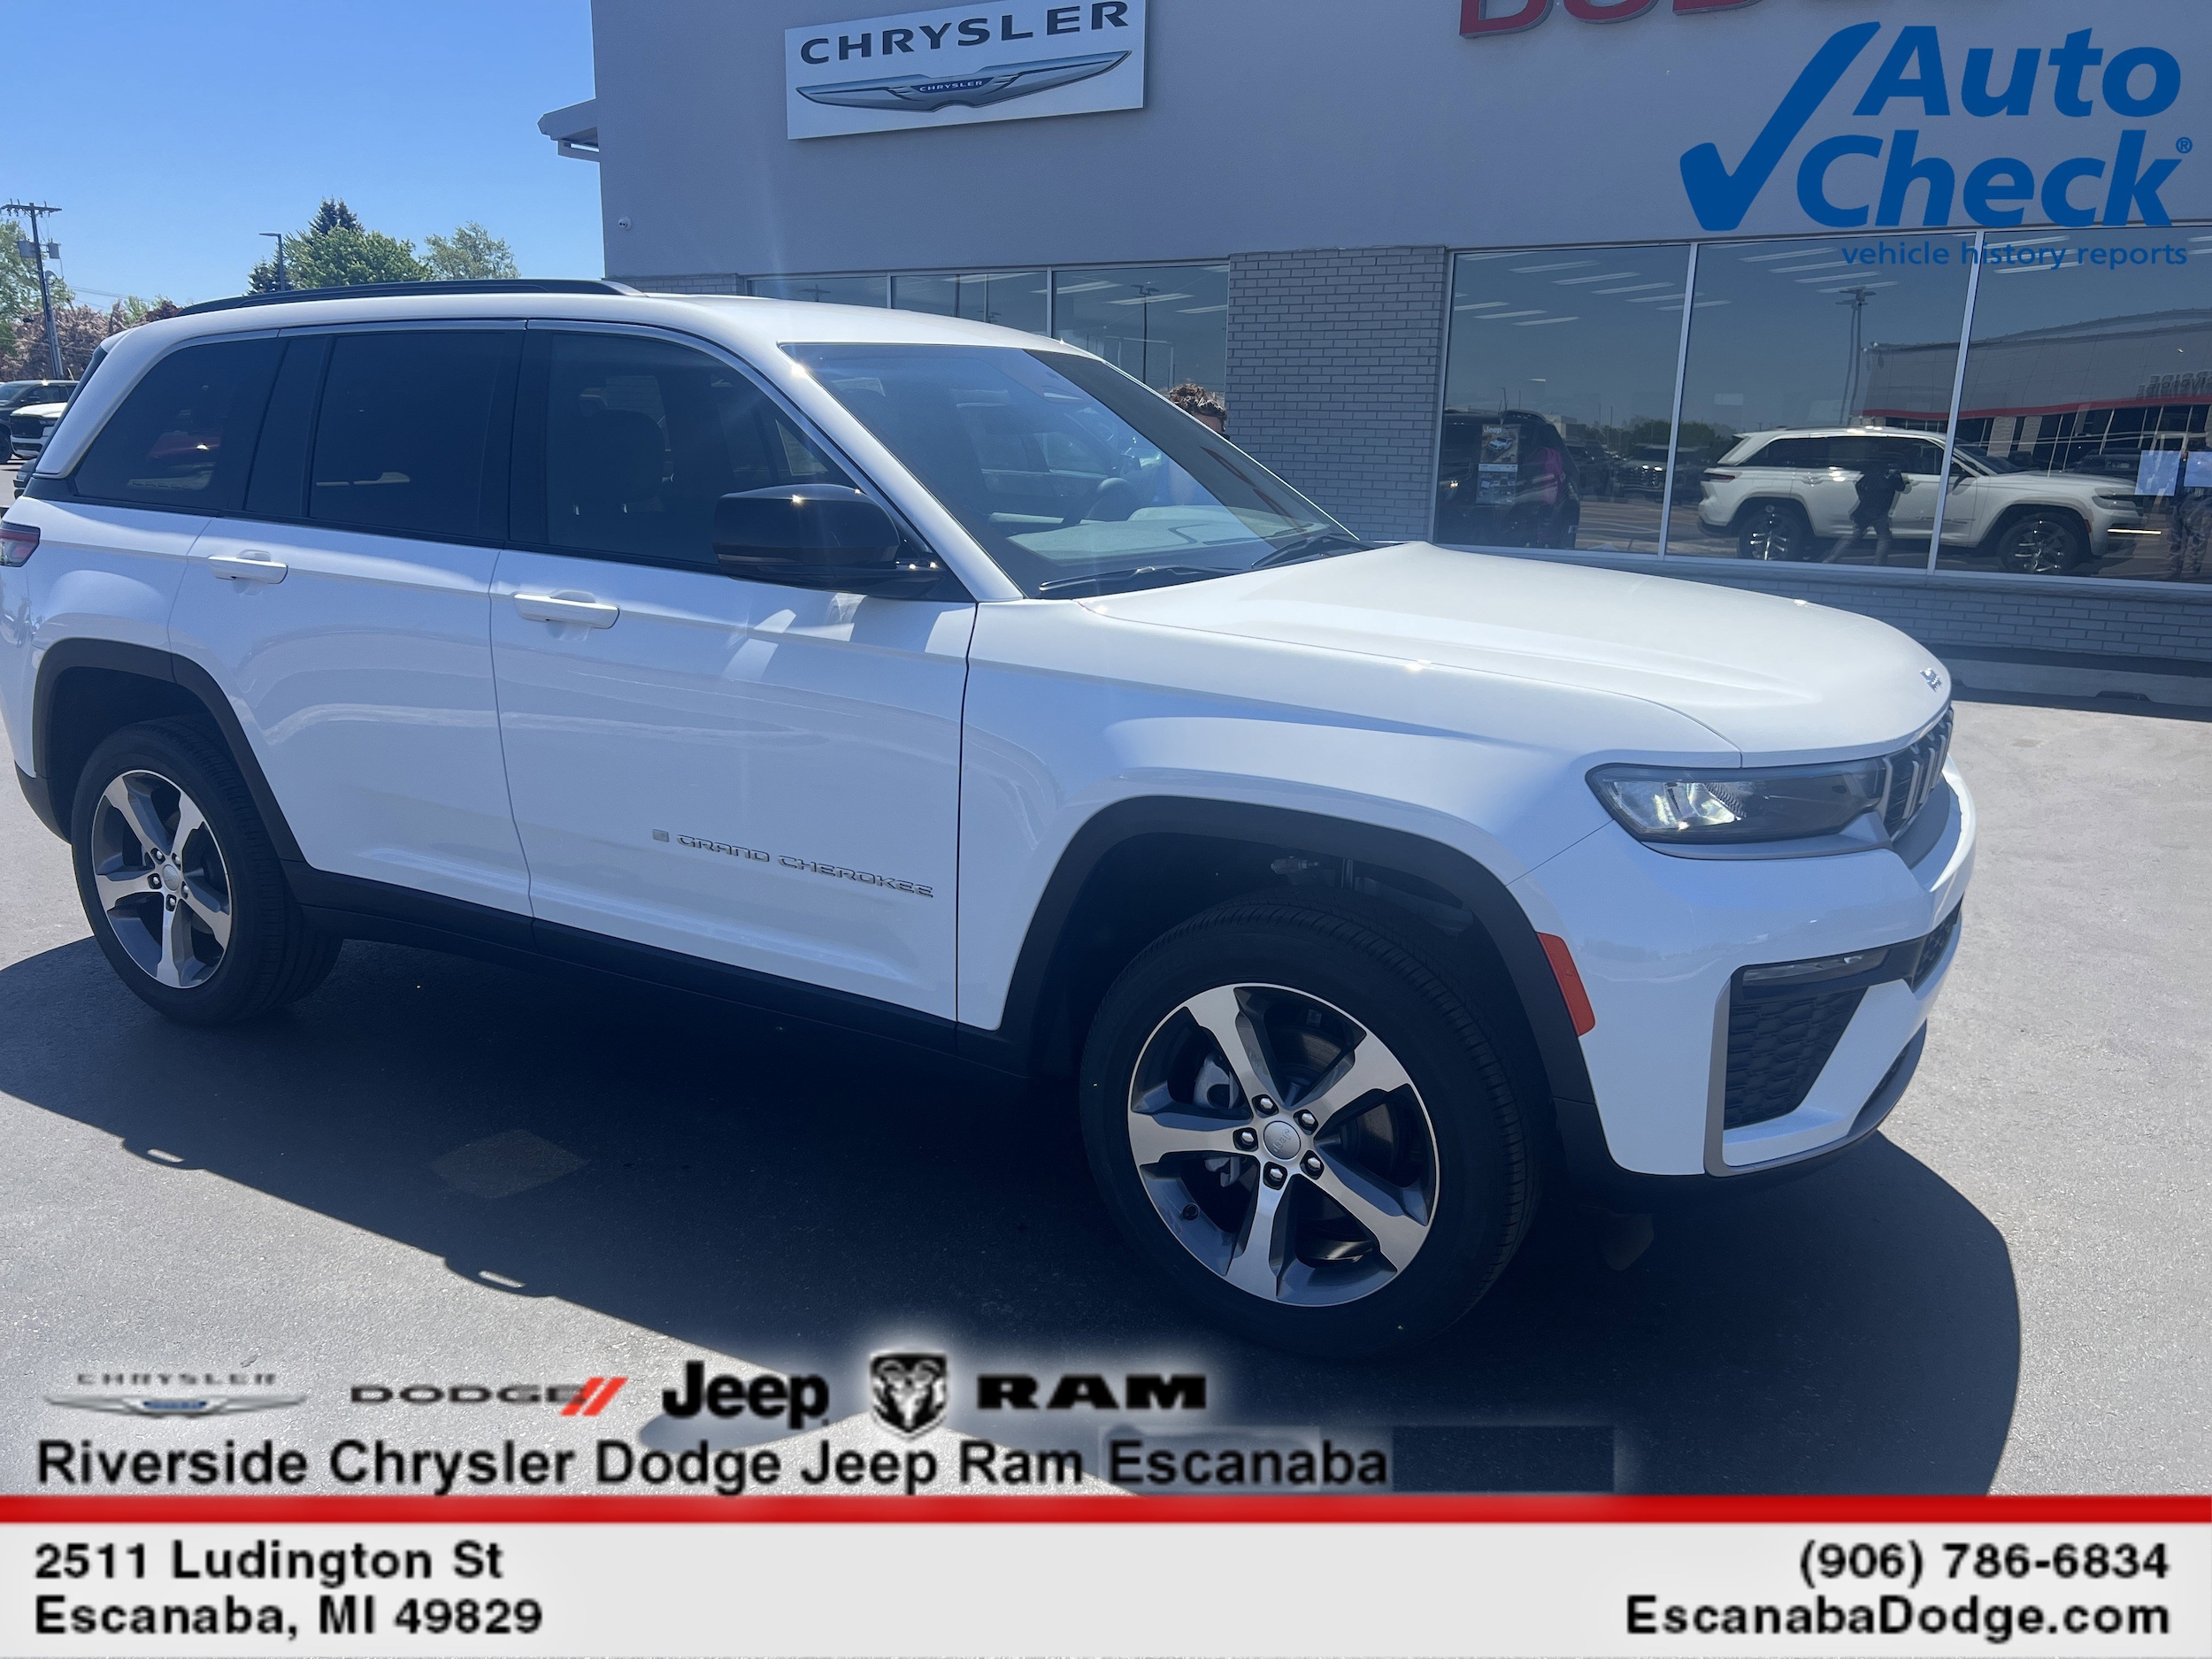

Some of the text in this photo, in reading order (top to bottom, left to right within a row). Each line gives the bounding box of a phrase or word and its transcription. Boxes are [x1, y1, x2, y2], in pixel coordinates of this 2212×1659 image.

[801, 1, 1129, 65] CHRYSLER
[919, 81, 983, 92] CHRYSLER
[677, 834, 933, 898] GRAND CHEROKEE
